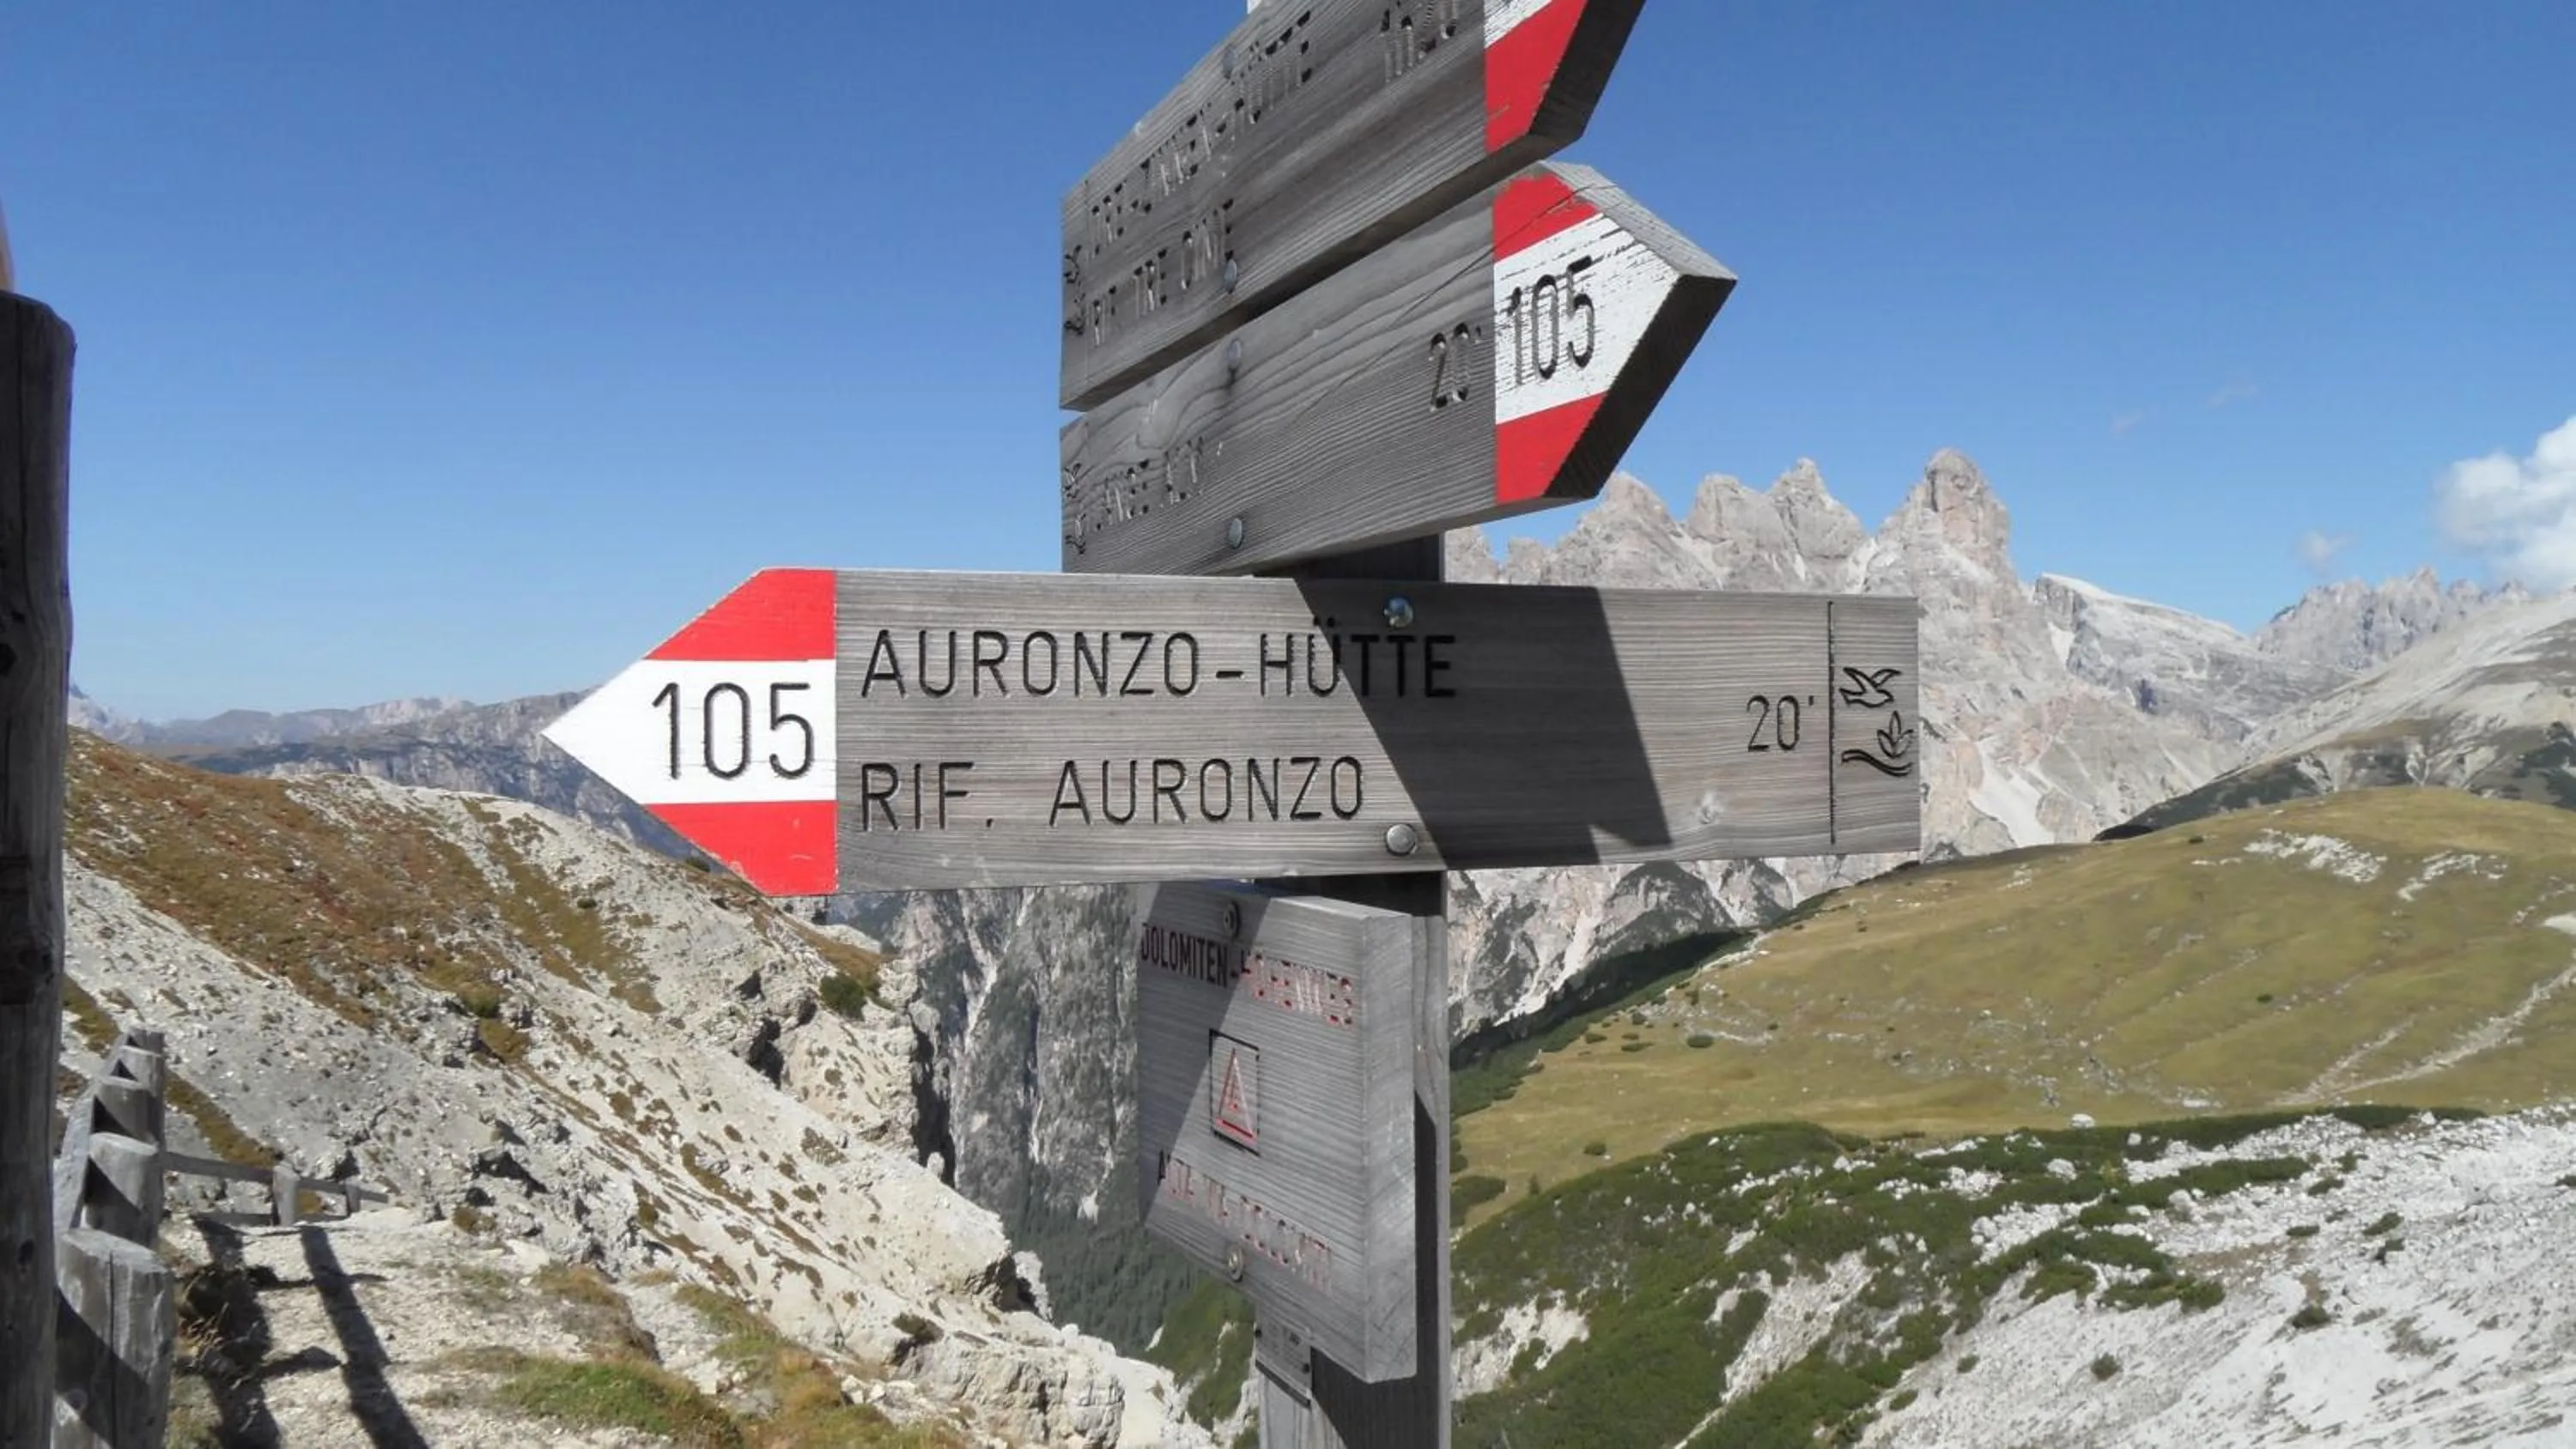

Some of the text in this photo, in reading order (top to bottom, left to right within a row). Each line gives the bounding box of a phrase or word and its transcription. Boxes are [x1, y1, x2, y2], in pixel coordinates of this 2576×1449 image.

[1505, 255, 1595, 385] 105
[652, 682, 815, 779] 105
[1747, 694, 1814, 752] 20'
[862, 755, 1363, 830] RIF. AURONZO
